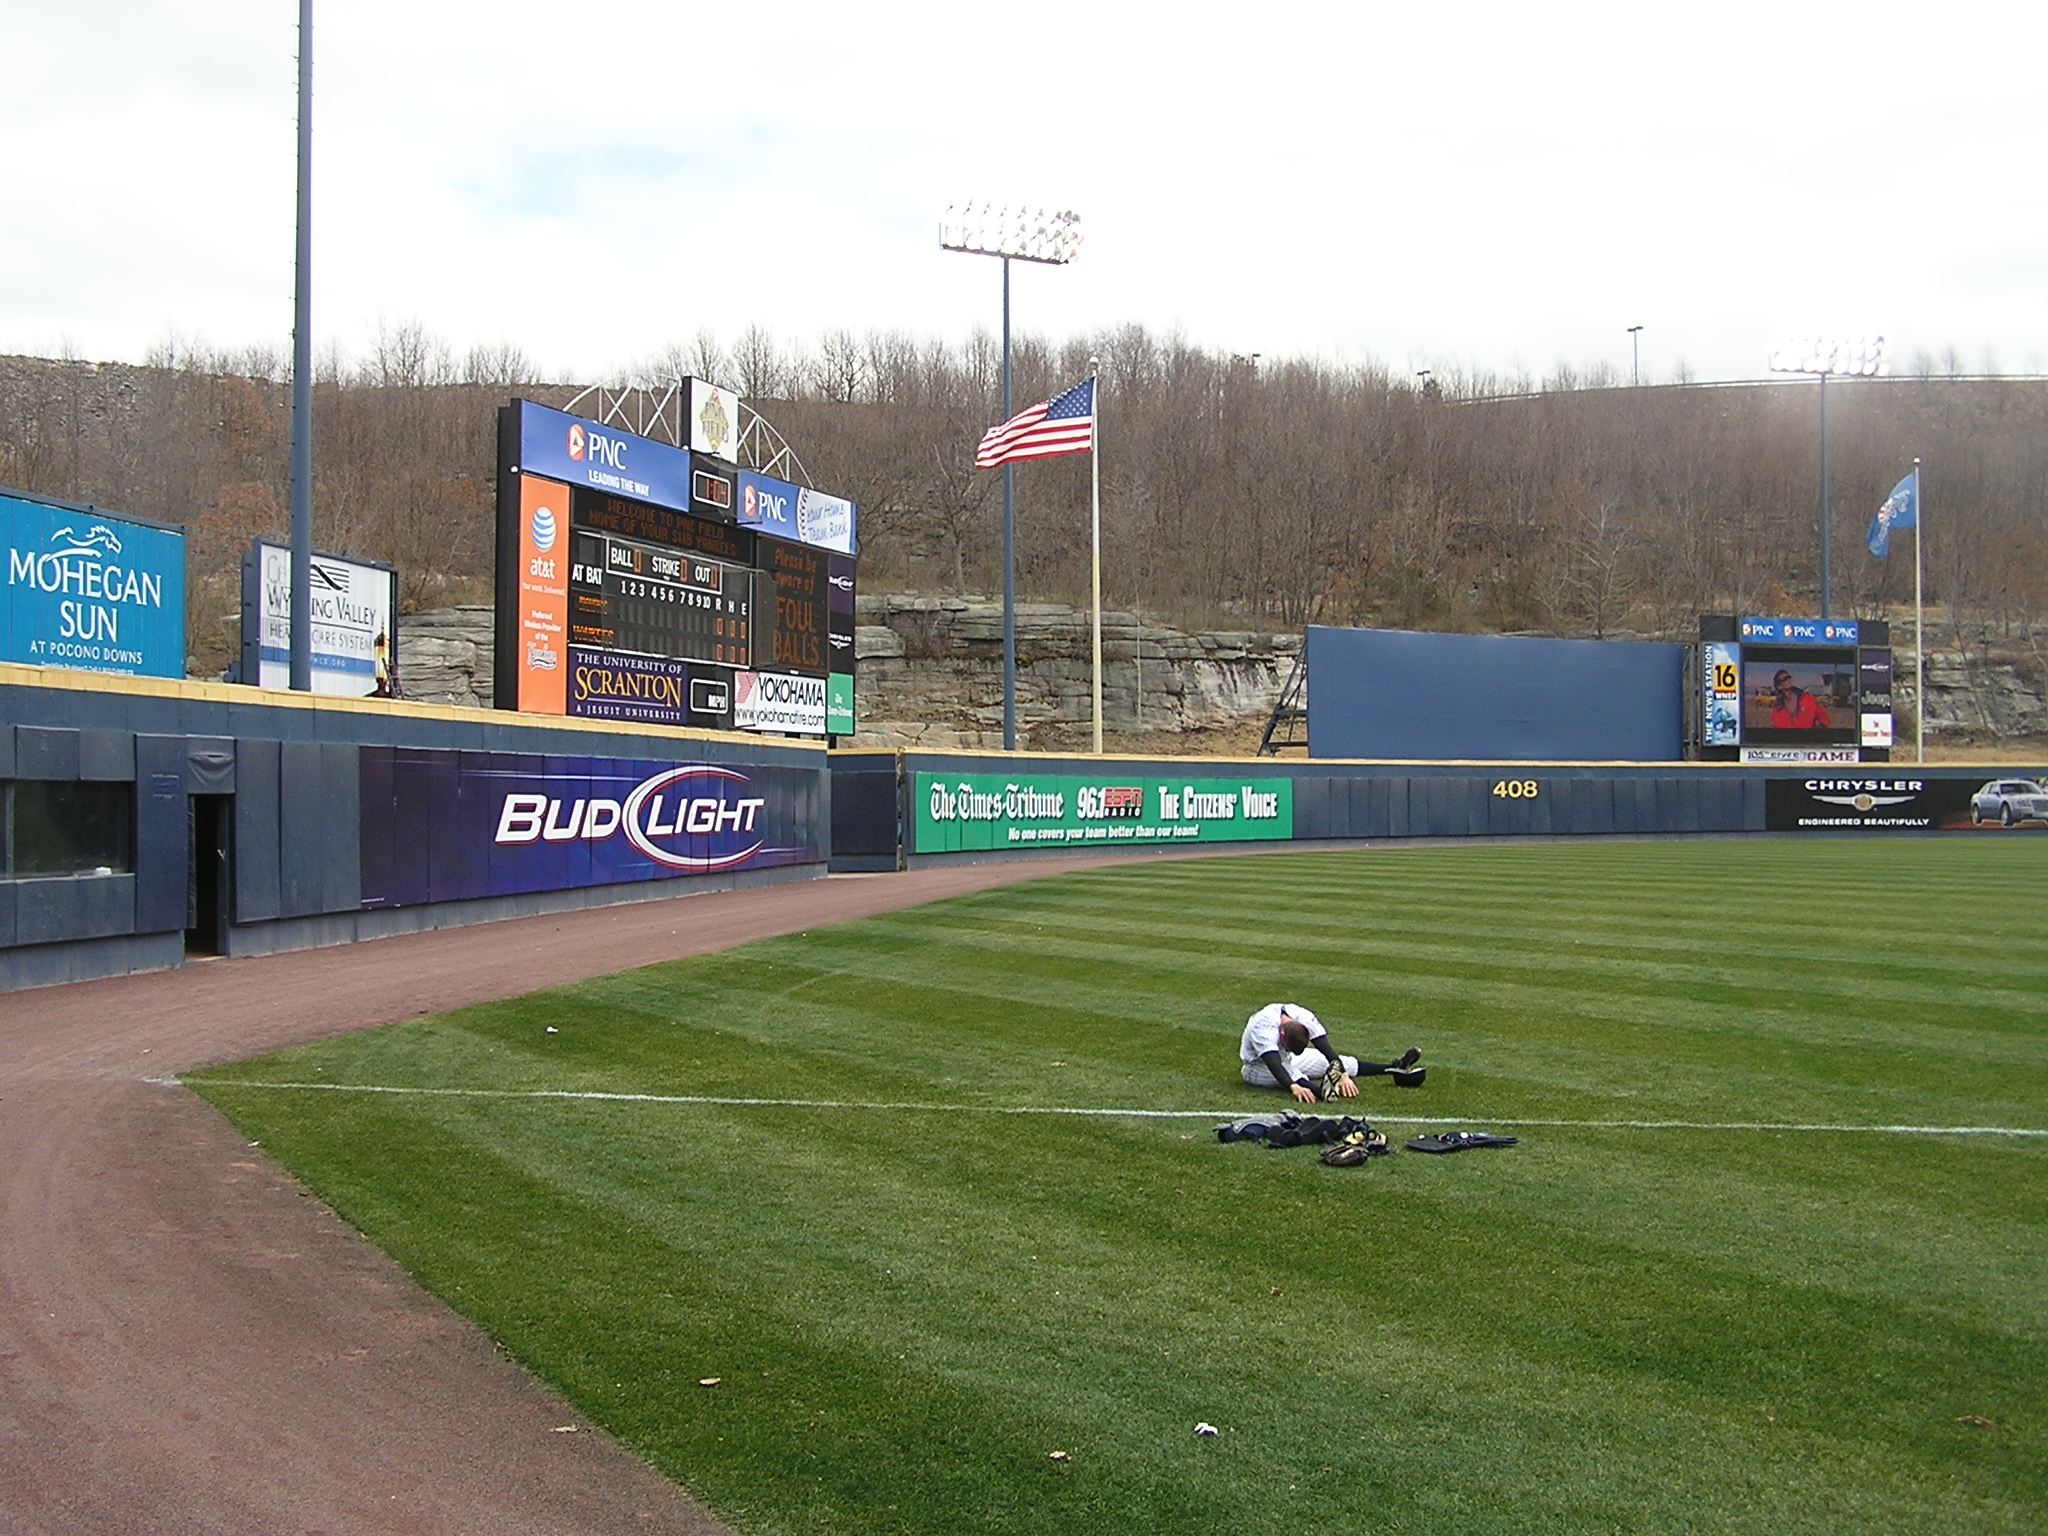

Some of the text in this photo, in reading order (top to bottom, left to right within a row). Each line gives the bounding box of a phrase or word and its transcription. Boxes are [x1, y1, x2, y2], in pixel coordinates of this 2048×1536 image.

[588, 432, 627, 470] PNC
[588, 470, 650, 497] LEADING THE WAY
[608, 499, 655, 523] WELCOME
[660, 509, 673, 526] TO
[700, 521, 724, 539] FIELD
[758, 491, 787, 523] PNC
[588, 510, 619, 530] HOME
[623, 518, 635, 533] OF
[641, 521, 668, 541] YOUR
[530, 556, 556, 580] at&t
[611, 547, 633, 568] BALL
[651, 555, 680, 577] STRIKE
[774, 548, 817, 573] Please be
[8, 548, 162, 608] MOHEGAN
[572, 563, 603, 585] AT BAT
[695, 566, 711, 583] OUT
[804, 576, 816, 595] of
[620, 580, 747, 616] 1 2 3 4 5 6 7 8 9 10 R H E
[60, 600, 118, 643] SUN
[336, 596, 376, 627] VALLEY
[776, 597, 818, 634] FOUL
[339, 634, 373, 652] SYSTEM
[1752, 625, 1856, 638] PNC PNC PNC
[30, 640, 143, 665] AT POCONO DOWNS
[773, 629, 820, 667] BALLS
[576, 653, 682, 675] THE UNIVERSITY OF
[1714, 665, 1736, 687] 16
[574, 666, 682, 708] SCRANTON
[758, 677, 825, 706] YOKOHAMA
[1705, 645, 1713, 741] THE NEWS STATION
[1861, 690, 1891, 707] Jeep
[576, 704, 681, 721] A JESUIT UNIVERSITY
[1807, 751, 1855, 762] GAME
[1493, 779, 1538, 798] 408
[1804, 779, 1922, 791] CHRYSLER
[930, 782, 1064, 820] The Times-Tribune
[1077, 786, 1143, 819] 96.1 ESPN
[1104, 807, 1141, 817] RADIO
[1158, 786, 1180, 819] THE
[1241, 786, 1278, 818] VOICE
[494, 793, 622, 846] BUD
[645, 795, 765, 837] LIGHT
[1798, 817, 1930, 827] ENGINEERED BEAUTIFULLY
[1008, 824, 1199, 842] No one covers your team better than our team!
